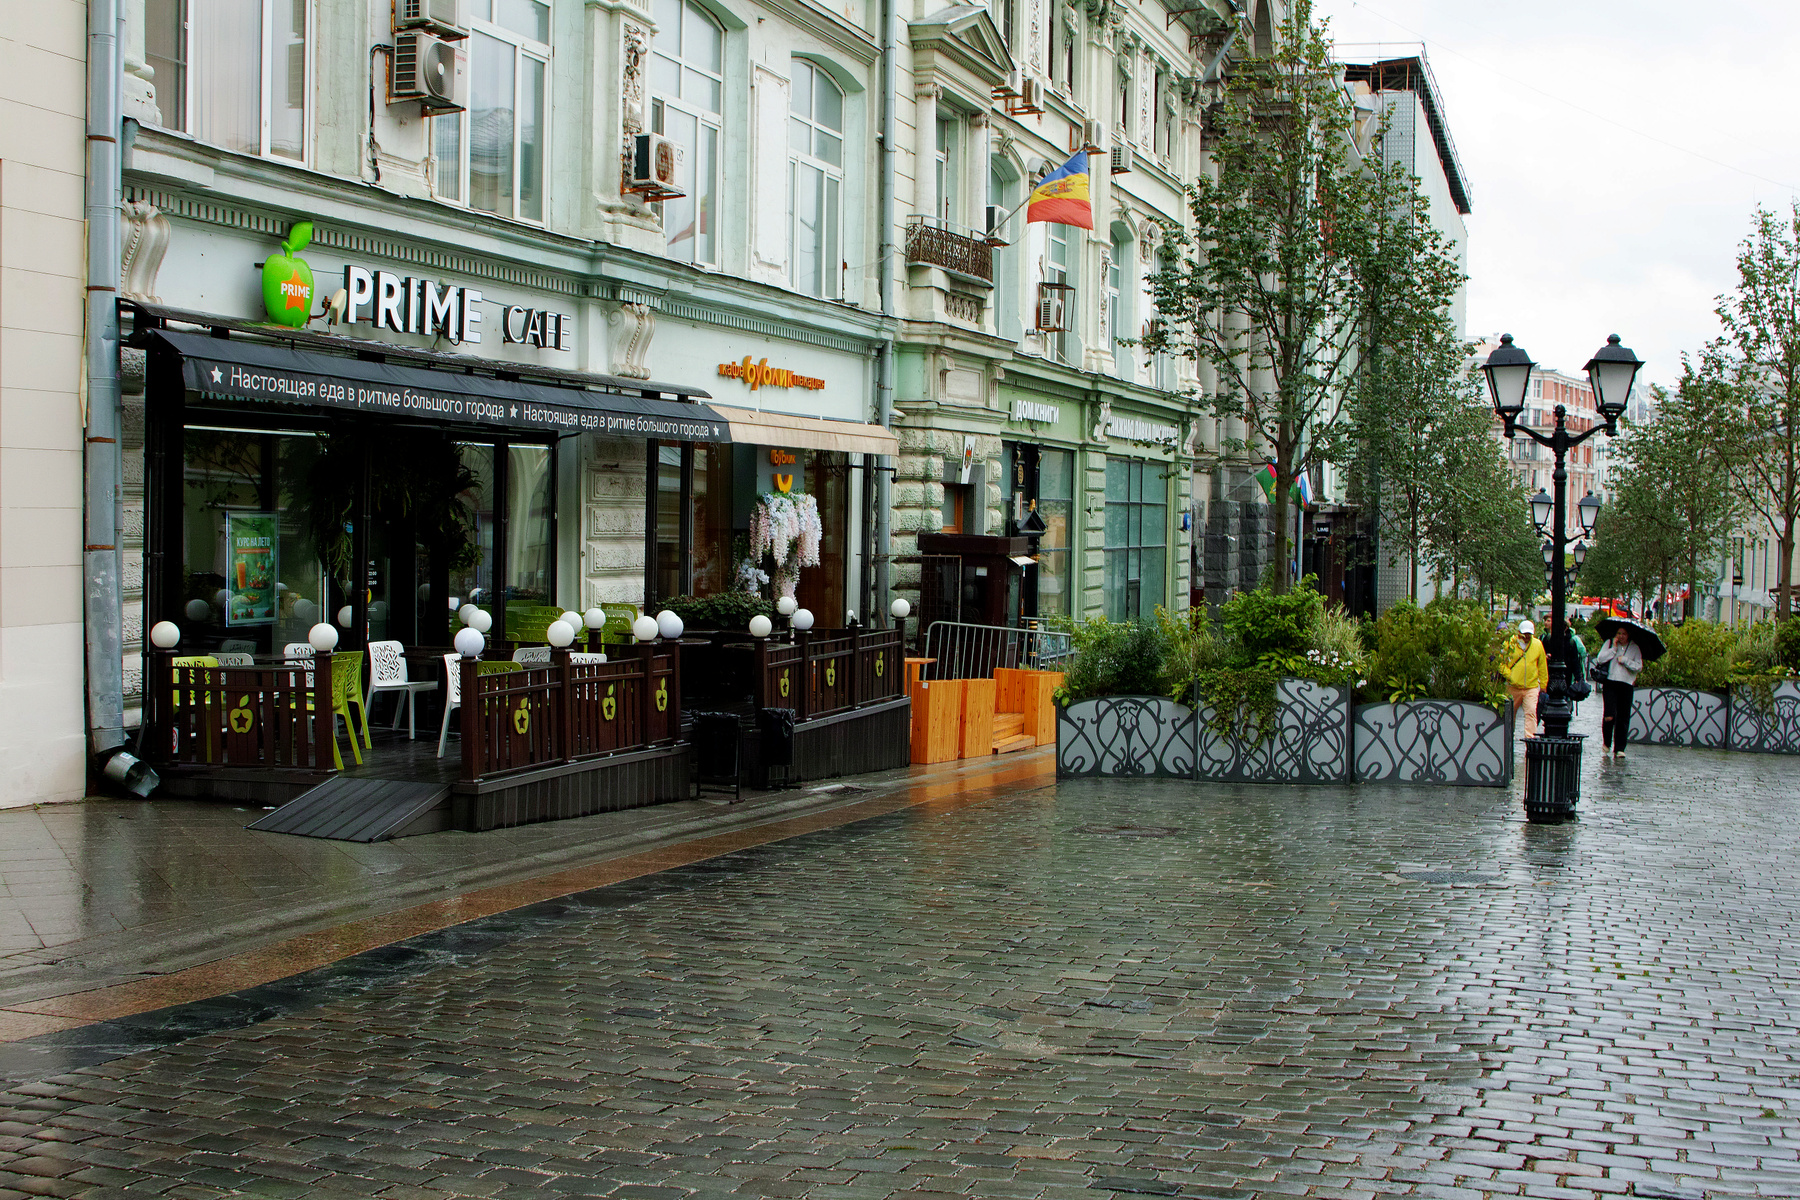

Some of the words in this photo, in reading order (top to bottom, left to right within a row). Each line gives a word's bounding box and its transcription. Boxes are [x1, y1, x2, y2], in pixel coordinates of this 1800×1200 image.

[281, 283, 310, 299] PRIME
[345, 265, 482, 344] PRIME
[504, 305, 571, 351] CAFE
[719, 361, 744, 379] кафе
[793, 375, 825, 390] пекарня
[230, 366, 316, 398] Настоящая
[319, 383, 345, 403] еда
[348, 387, 355, 401] в
[358, 388, 400, 407] ритме
[403, 389, 462, 414] большого
[465, 401, 505, 420] города
[523, 404, 578, 426] Настоящая
[580, 414, 598, 429] еда
[599, 416, 605, 428] в
[607, 416, 635, 432] ритме
[637, 416, 679, 434] большого
[679, 422, 709, 438] города
[1016, 400, 1034, 421] ДОМ
[1034, 403, 1060, 424] КНИГИ
[237, 537, 250, 547] КУРС
[250, 537, 258, 547] НА
[257, 536, 270, 547] ЛЕТО
